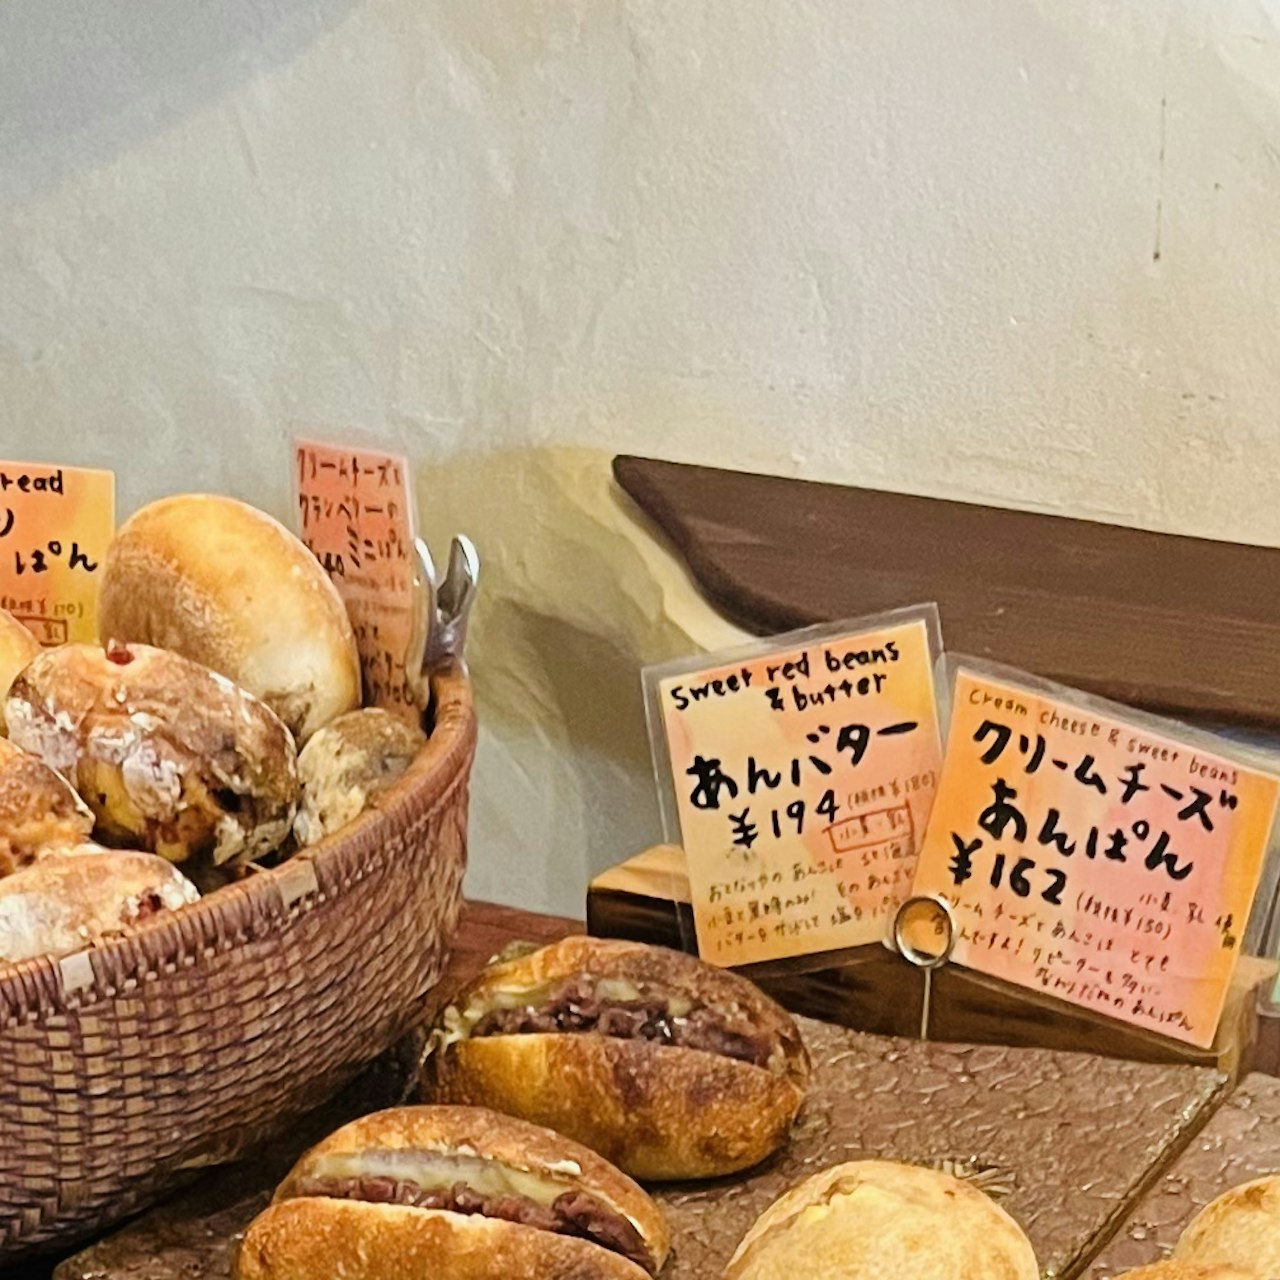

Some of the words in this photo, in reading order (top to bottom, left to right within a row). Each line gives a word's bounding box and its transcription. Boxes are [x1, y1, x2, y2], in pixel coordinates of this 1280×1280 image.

[764, 687, 785, 712] &
[792, 672, 888, 711] butter
[766, 652, 810, 682] red
[825, 640, 900, 672] beans
[686, 720, 918, 809] あんバター
[968, 688, 1029, 718] Cream
[1039, 709, 1101, 738] cheese
[1108, 728, 1120, 748] &
[1126, 736, 1180, 764] sweet
[1189, 756, 1239, 784] beans
[972, 718, 1239, 834] クリームチーズ
[727, 789, 840, 849] ¥194
[978, 778, 1194, 883] あんぱん
[947, 831, 1068, 906] ¥162
